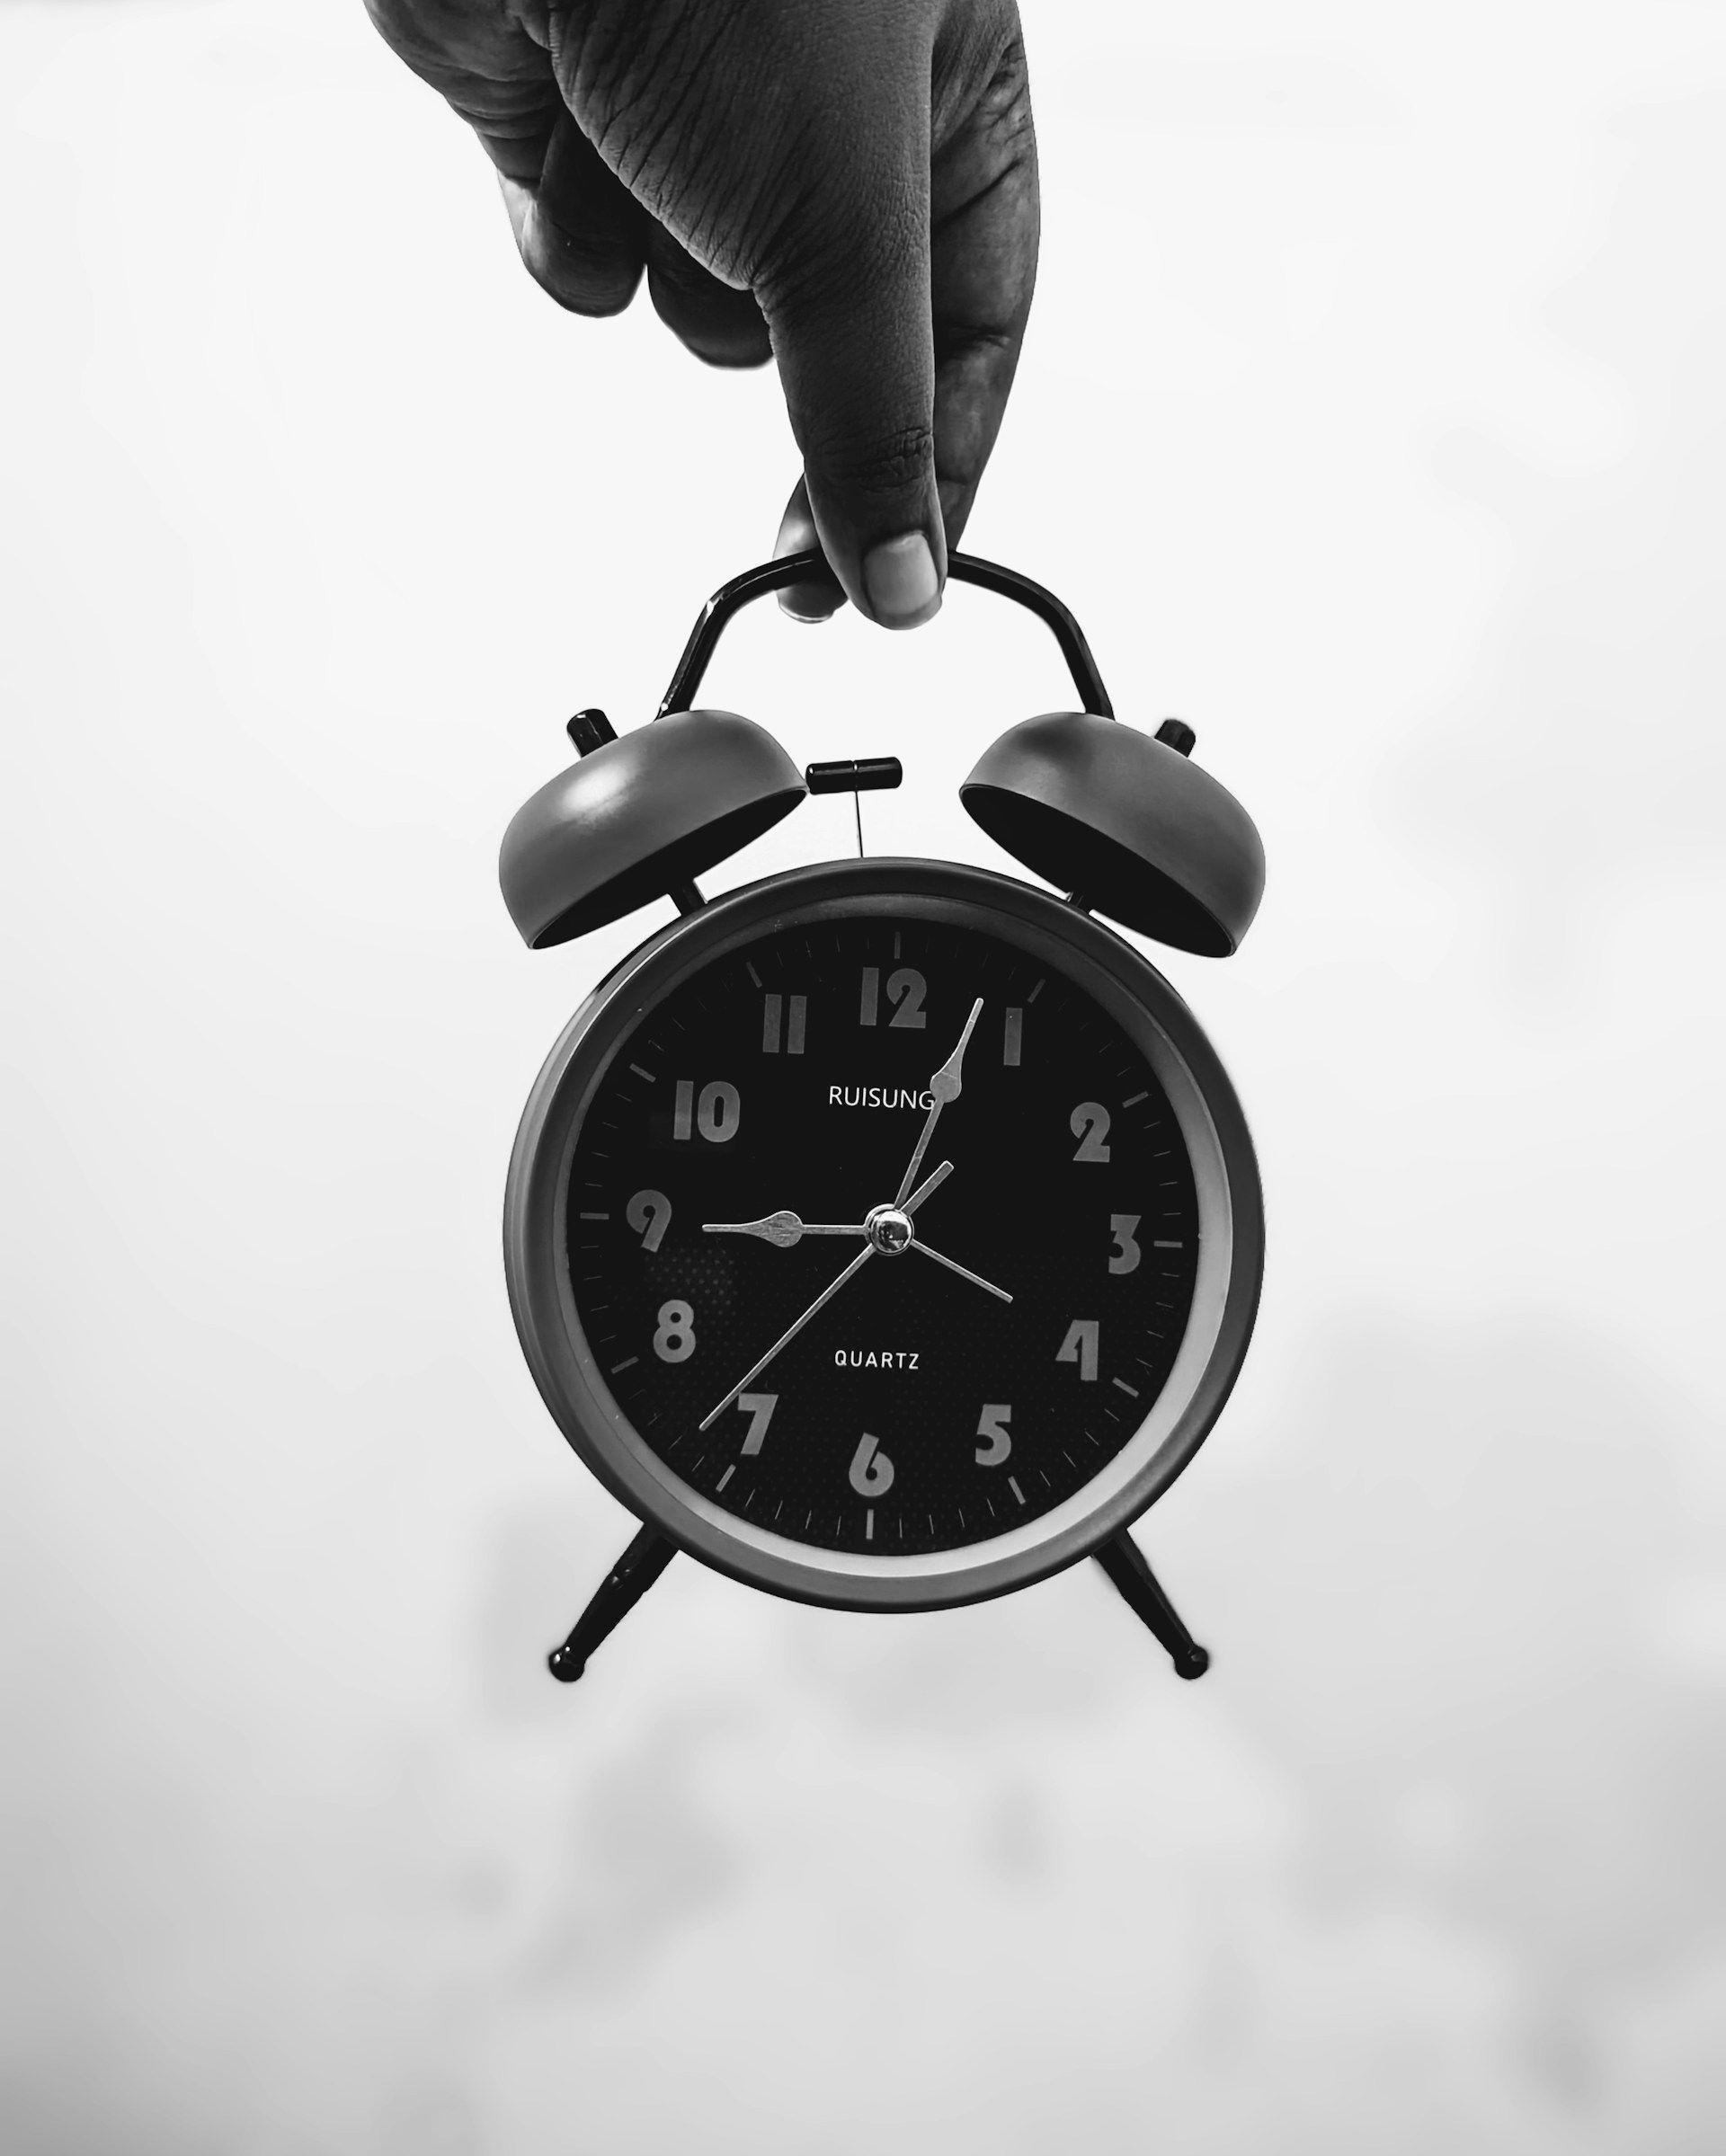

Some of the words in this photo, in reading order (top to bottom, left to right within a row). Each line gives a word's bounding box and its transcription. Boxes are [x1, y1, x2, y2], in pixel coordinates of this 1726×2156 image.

[762, 993, 807, 1055] 11
[859, 967, 927, 1029] 12
[1003, 1007, 1023, 1067] 1
[672, 1079, 741, 1143] 10
[828, 1084, 936, 1111] RUISUNG
[1069, 1101, 1111, 1163] 2
[626, 1189, 672, 1253] 9
[1108, 1213, 1142, 1275] 3
[653, 1299, 697, 1363] 8
[834, 1349, 920, 1371] QUARTZ
[1054, 1318, 1099, 1382] 4
[737, 1392, 779, 1456] 7
[974, 1403, 1012, 1468] 5
[848, 1432, 895, 1498] 6
